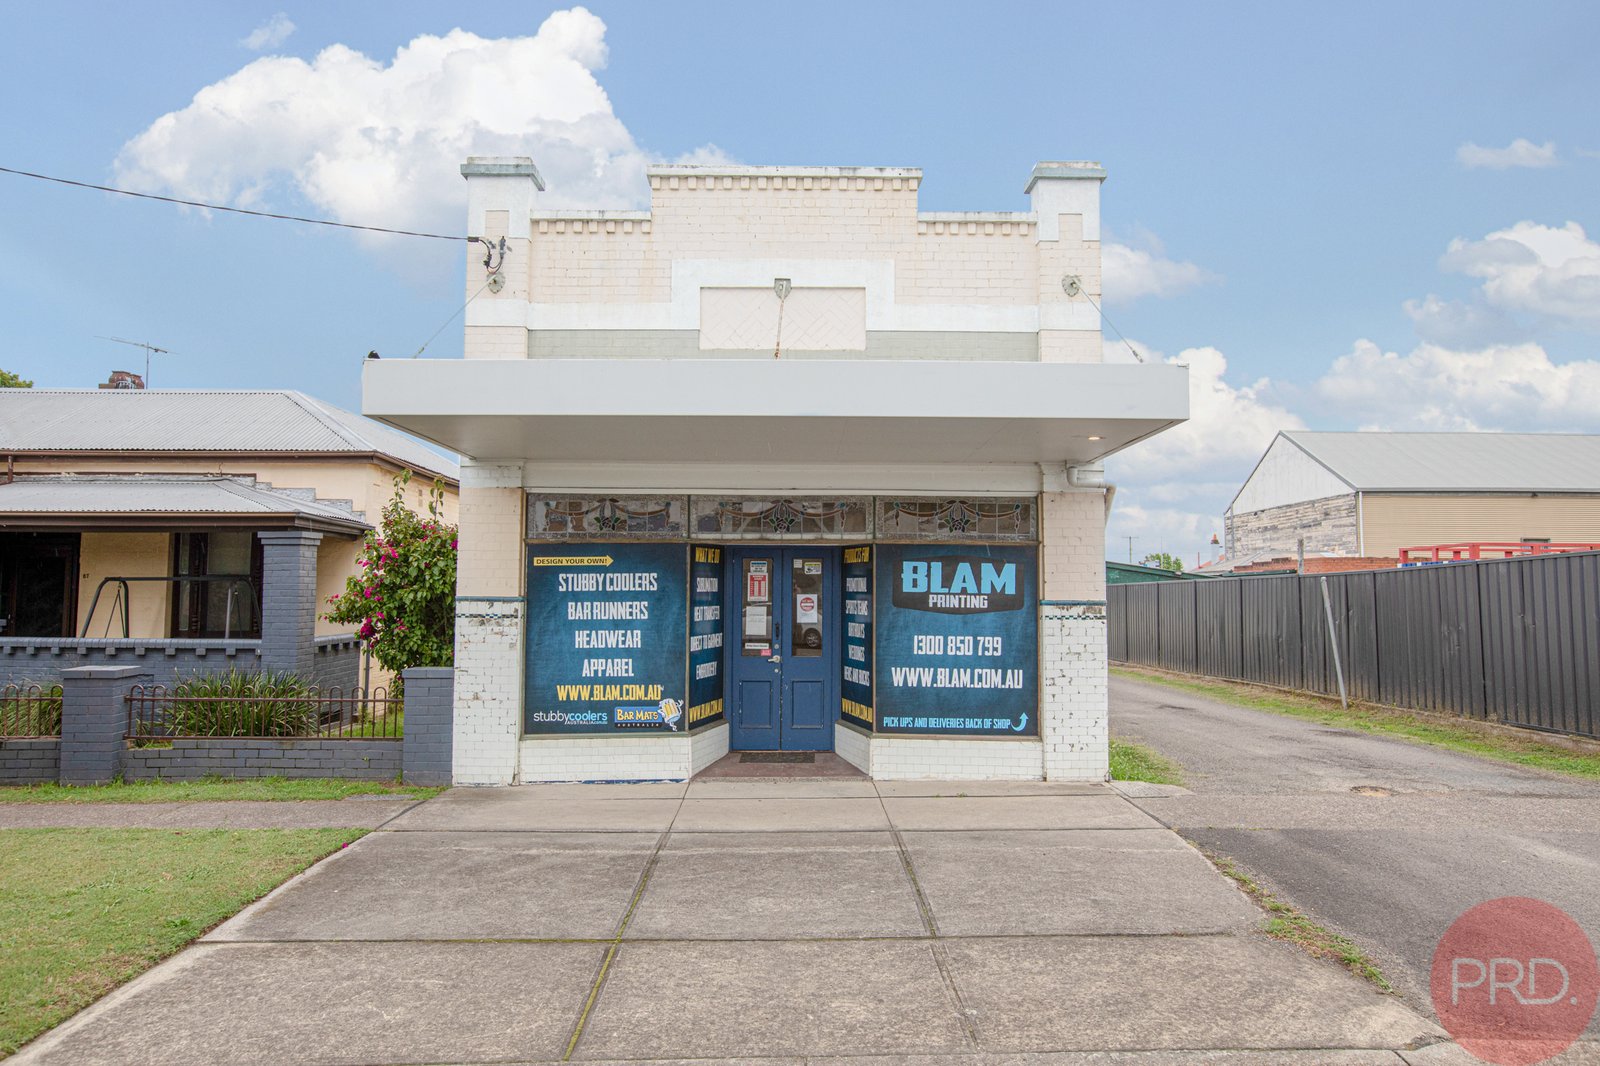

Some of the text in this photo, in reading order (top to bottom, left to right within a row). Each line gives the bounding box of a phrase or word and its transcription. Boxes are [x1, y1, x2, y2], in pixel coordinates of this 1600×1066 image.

[559, 573, 657, 591] STUBBY COOLERS
[901, 561, 1016, 595] BLAM
[568, 601, 648, 620] BAR RUNNERS
[928, 594, 988, 609] PRINTING
[575, 630, 641, 648] HEADWEAR
[914, 635, 1002, 656] 1300 850 799
[582, 659, 634, 677] APPAREL
[892, 667, 1023, 689] WWW.BLAM.COM.AU
[557, 684, 662, 701] WWW.BLAM.COM.AU
[533, 710, 608, 724] stubbycoolers
[883, 717, 1011, 729] PICK UPS AND DELIVERIES BACK OF SHOP
